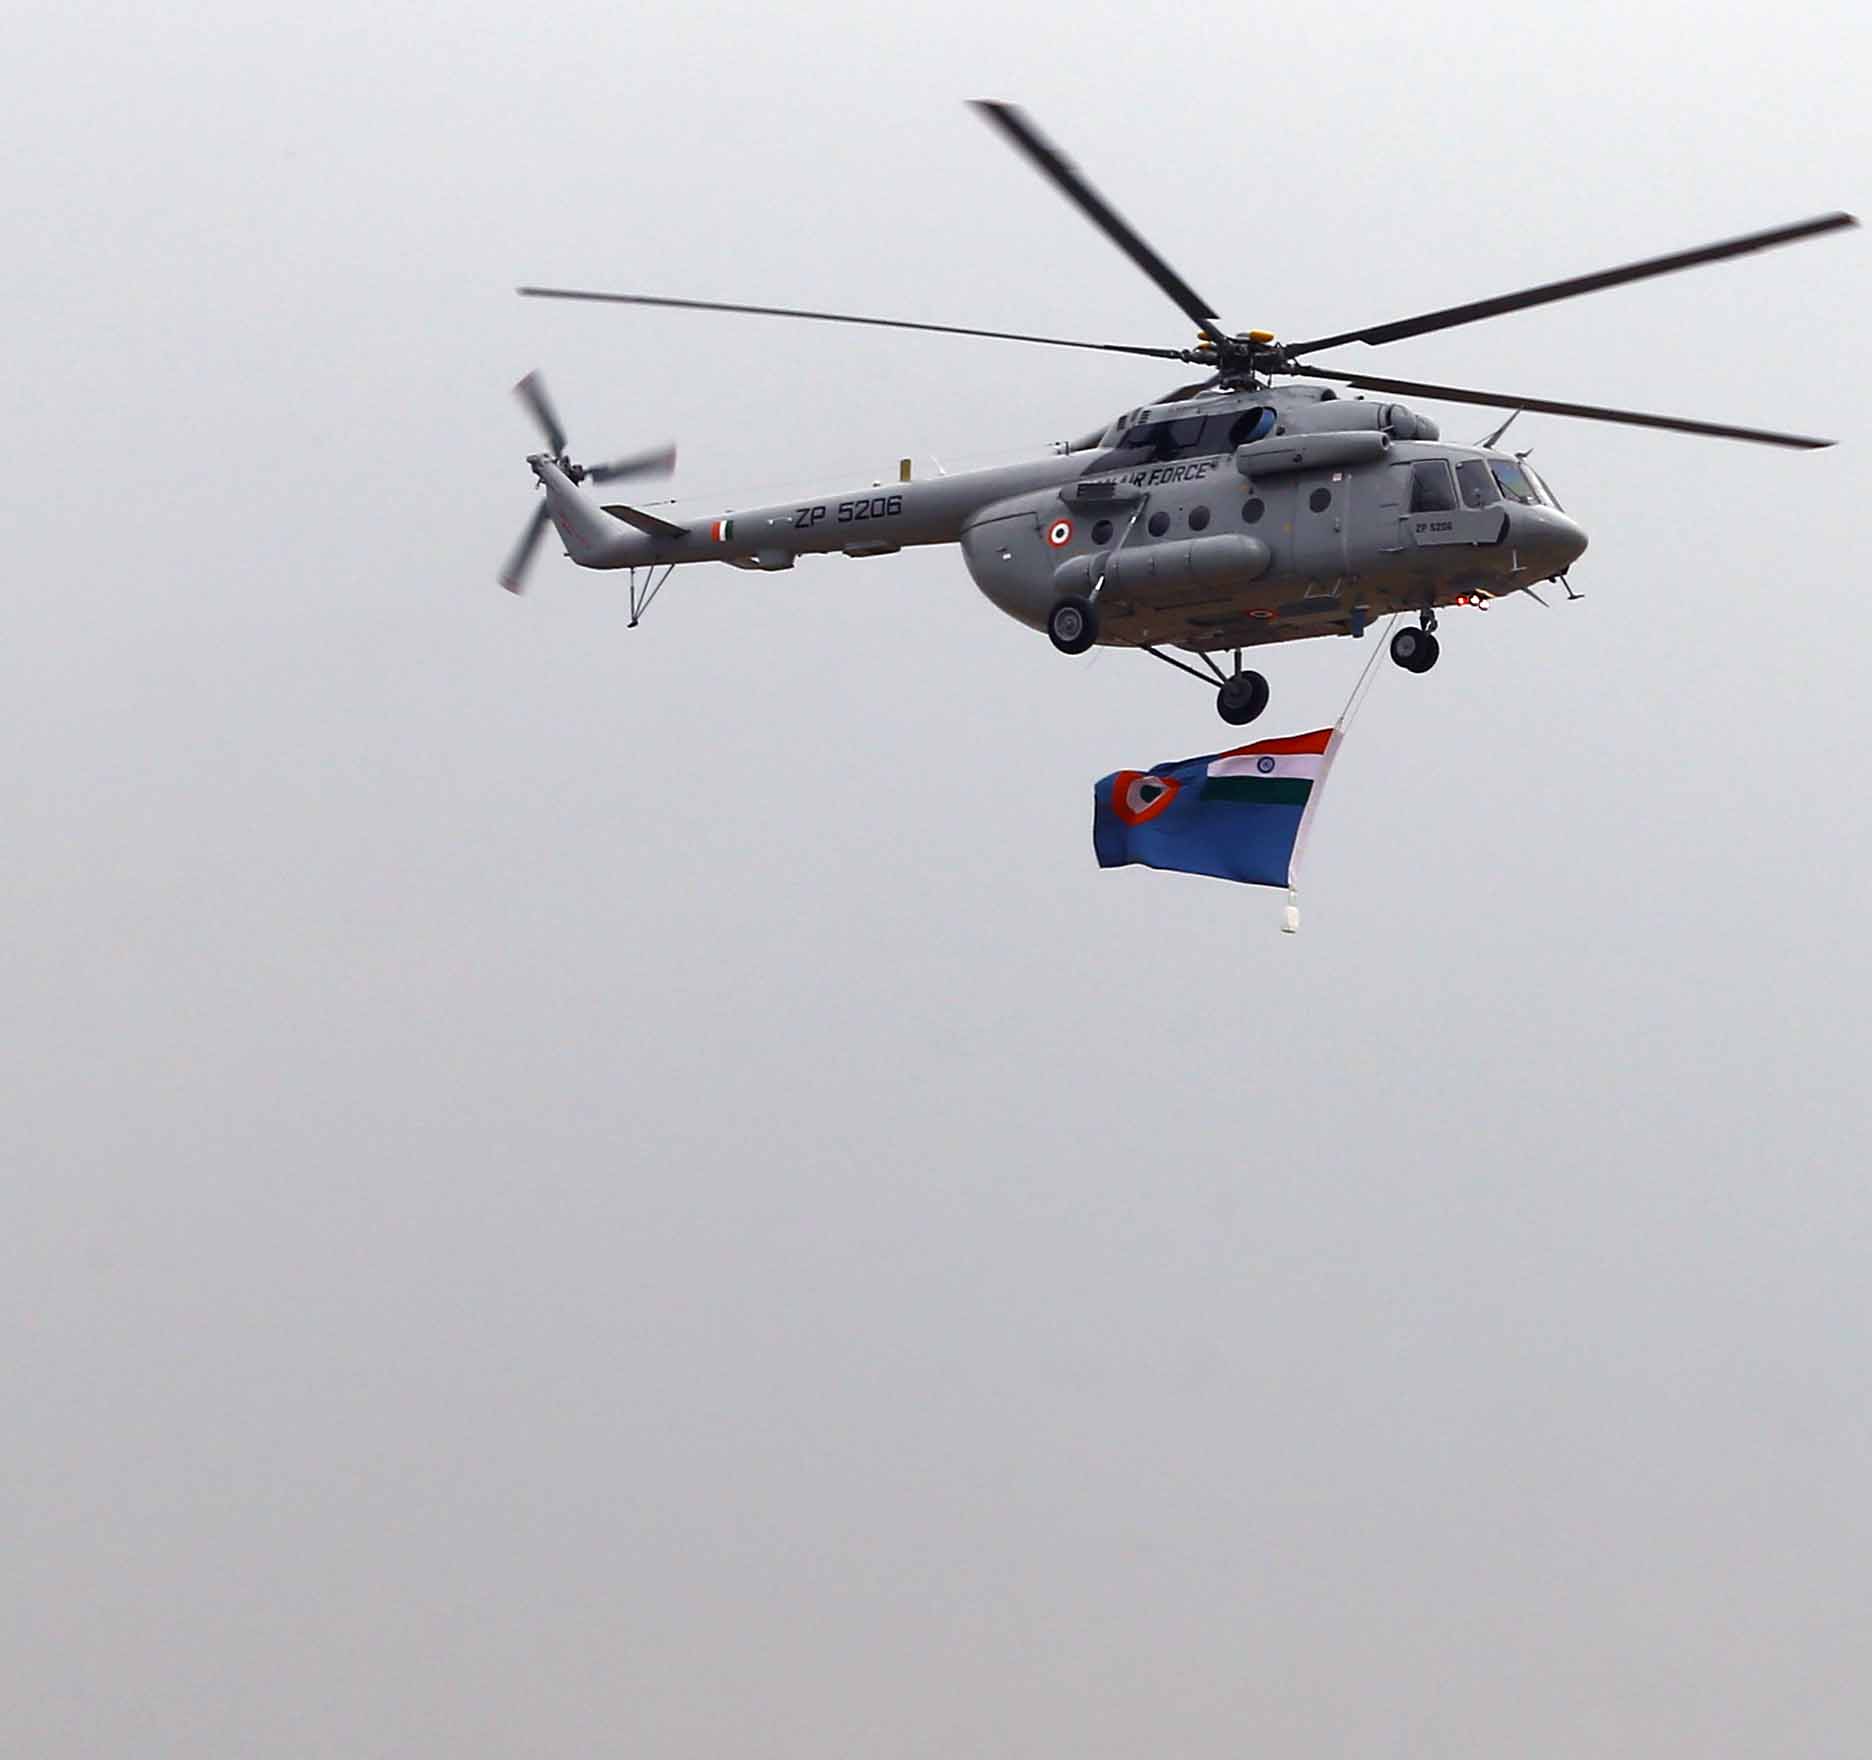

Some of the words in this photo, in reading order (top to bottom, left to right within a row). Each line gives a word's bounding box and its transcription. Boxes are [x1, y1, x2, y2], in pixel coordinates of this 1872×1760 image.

[1147, 462, 1210, 486] FORCE
[794, 507, 827, 529] ZP
[837, 496, 904, 523] 5206
